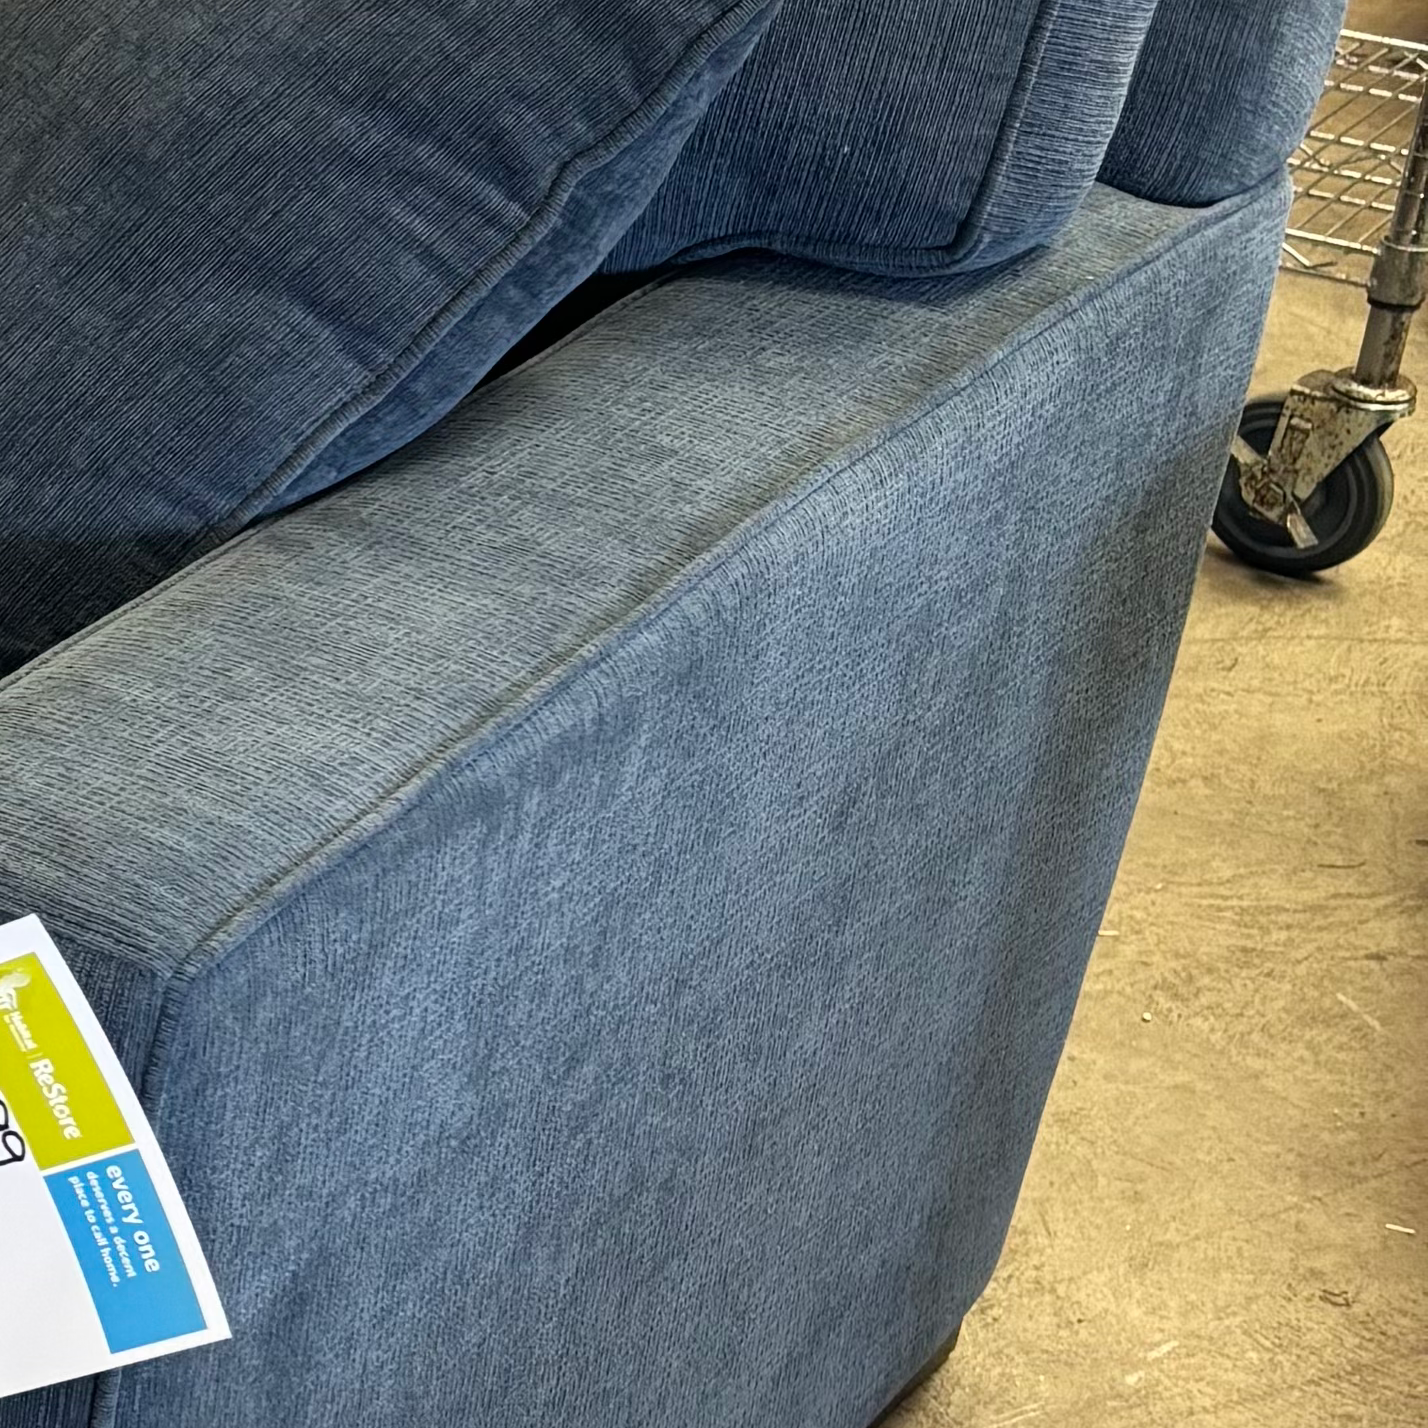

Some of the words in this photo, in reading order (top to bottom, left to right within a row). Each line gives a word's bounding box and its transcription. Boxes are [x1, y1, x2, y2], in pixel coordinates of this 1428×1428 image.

[28, 1057, 83, 1141] ReStore
[67, 1174, 91, 1208] place
[86, 1170, 115, 1224] deserves
[84, 1209, 97, 1223] to
[90, 1224, 109, 1247] call
[106, 1164, 144, 1224] every
[133, 1229, 161, 1273] one
[108, 1225, 119, 1235] a
[99, 1247, 121, 1287] home.
[113, 1235, 138, 1279] decent
